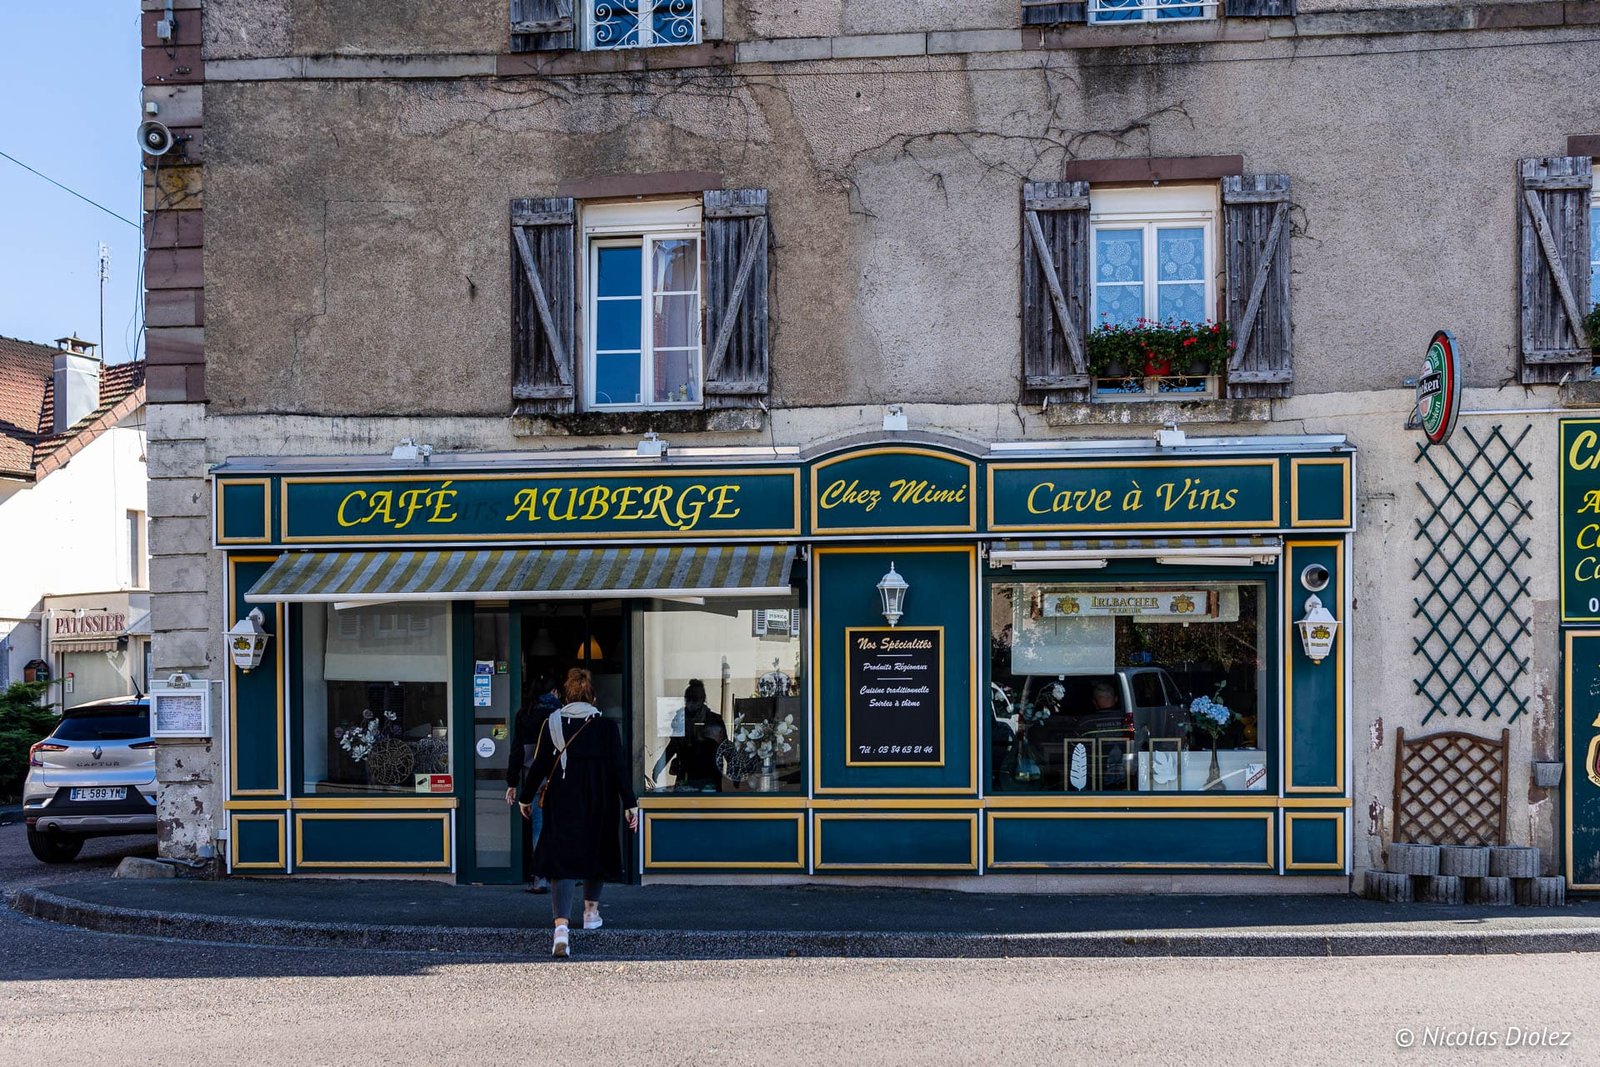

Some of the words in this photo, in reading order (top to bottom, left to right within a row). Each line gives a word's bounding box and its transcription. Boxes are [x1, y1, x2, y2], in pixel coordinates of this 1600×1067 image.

[820, 479, 881, 512] Chez
[889, 479, 967, 504] Mimi
[1027, 482, 1112, 514] Cave
[1122, 480, 1143, 511] à
[1156, 478, 1239, 512] Vins
[337, 481, 458, 528] CAFÉ
[505, 485, 740, 531] AUBERGE
[1091, 596, 1160, 608] IRLBACHER
[857, 638, 877, 650] Nos
[880, 638, 932, 651] Spécialités
[863, 662, 892, 671] Produits
[894, 662, 928, 672] Régionaux
[860, 685, 885, 695] Cuisine
[886, 686, 930, 694] traditionnelle
[869, 698, 893, 707] Soirées
[901, 699, 921, 707] thème
[878, 745, 889, 754] 03
[891, 745, 900, 753] 84
[901, 745, 912, 754] 63
[913, 745, 922, 753] 21
[923, 745, 933, 753] 46
